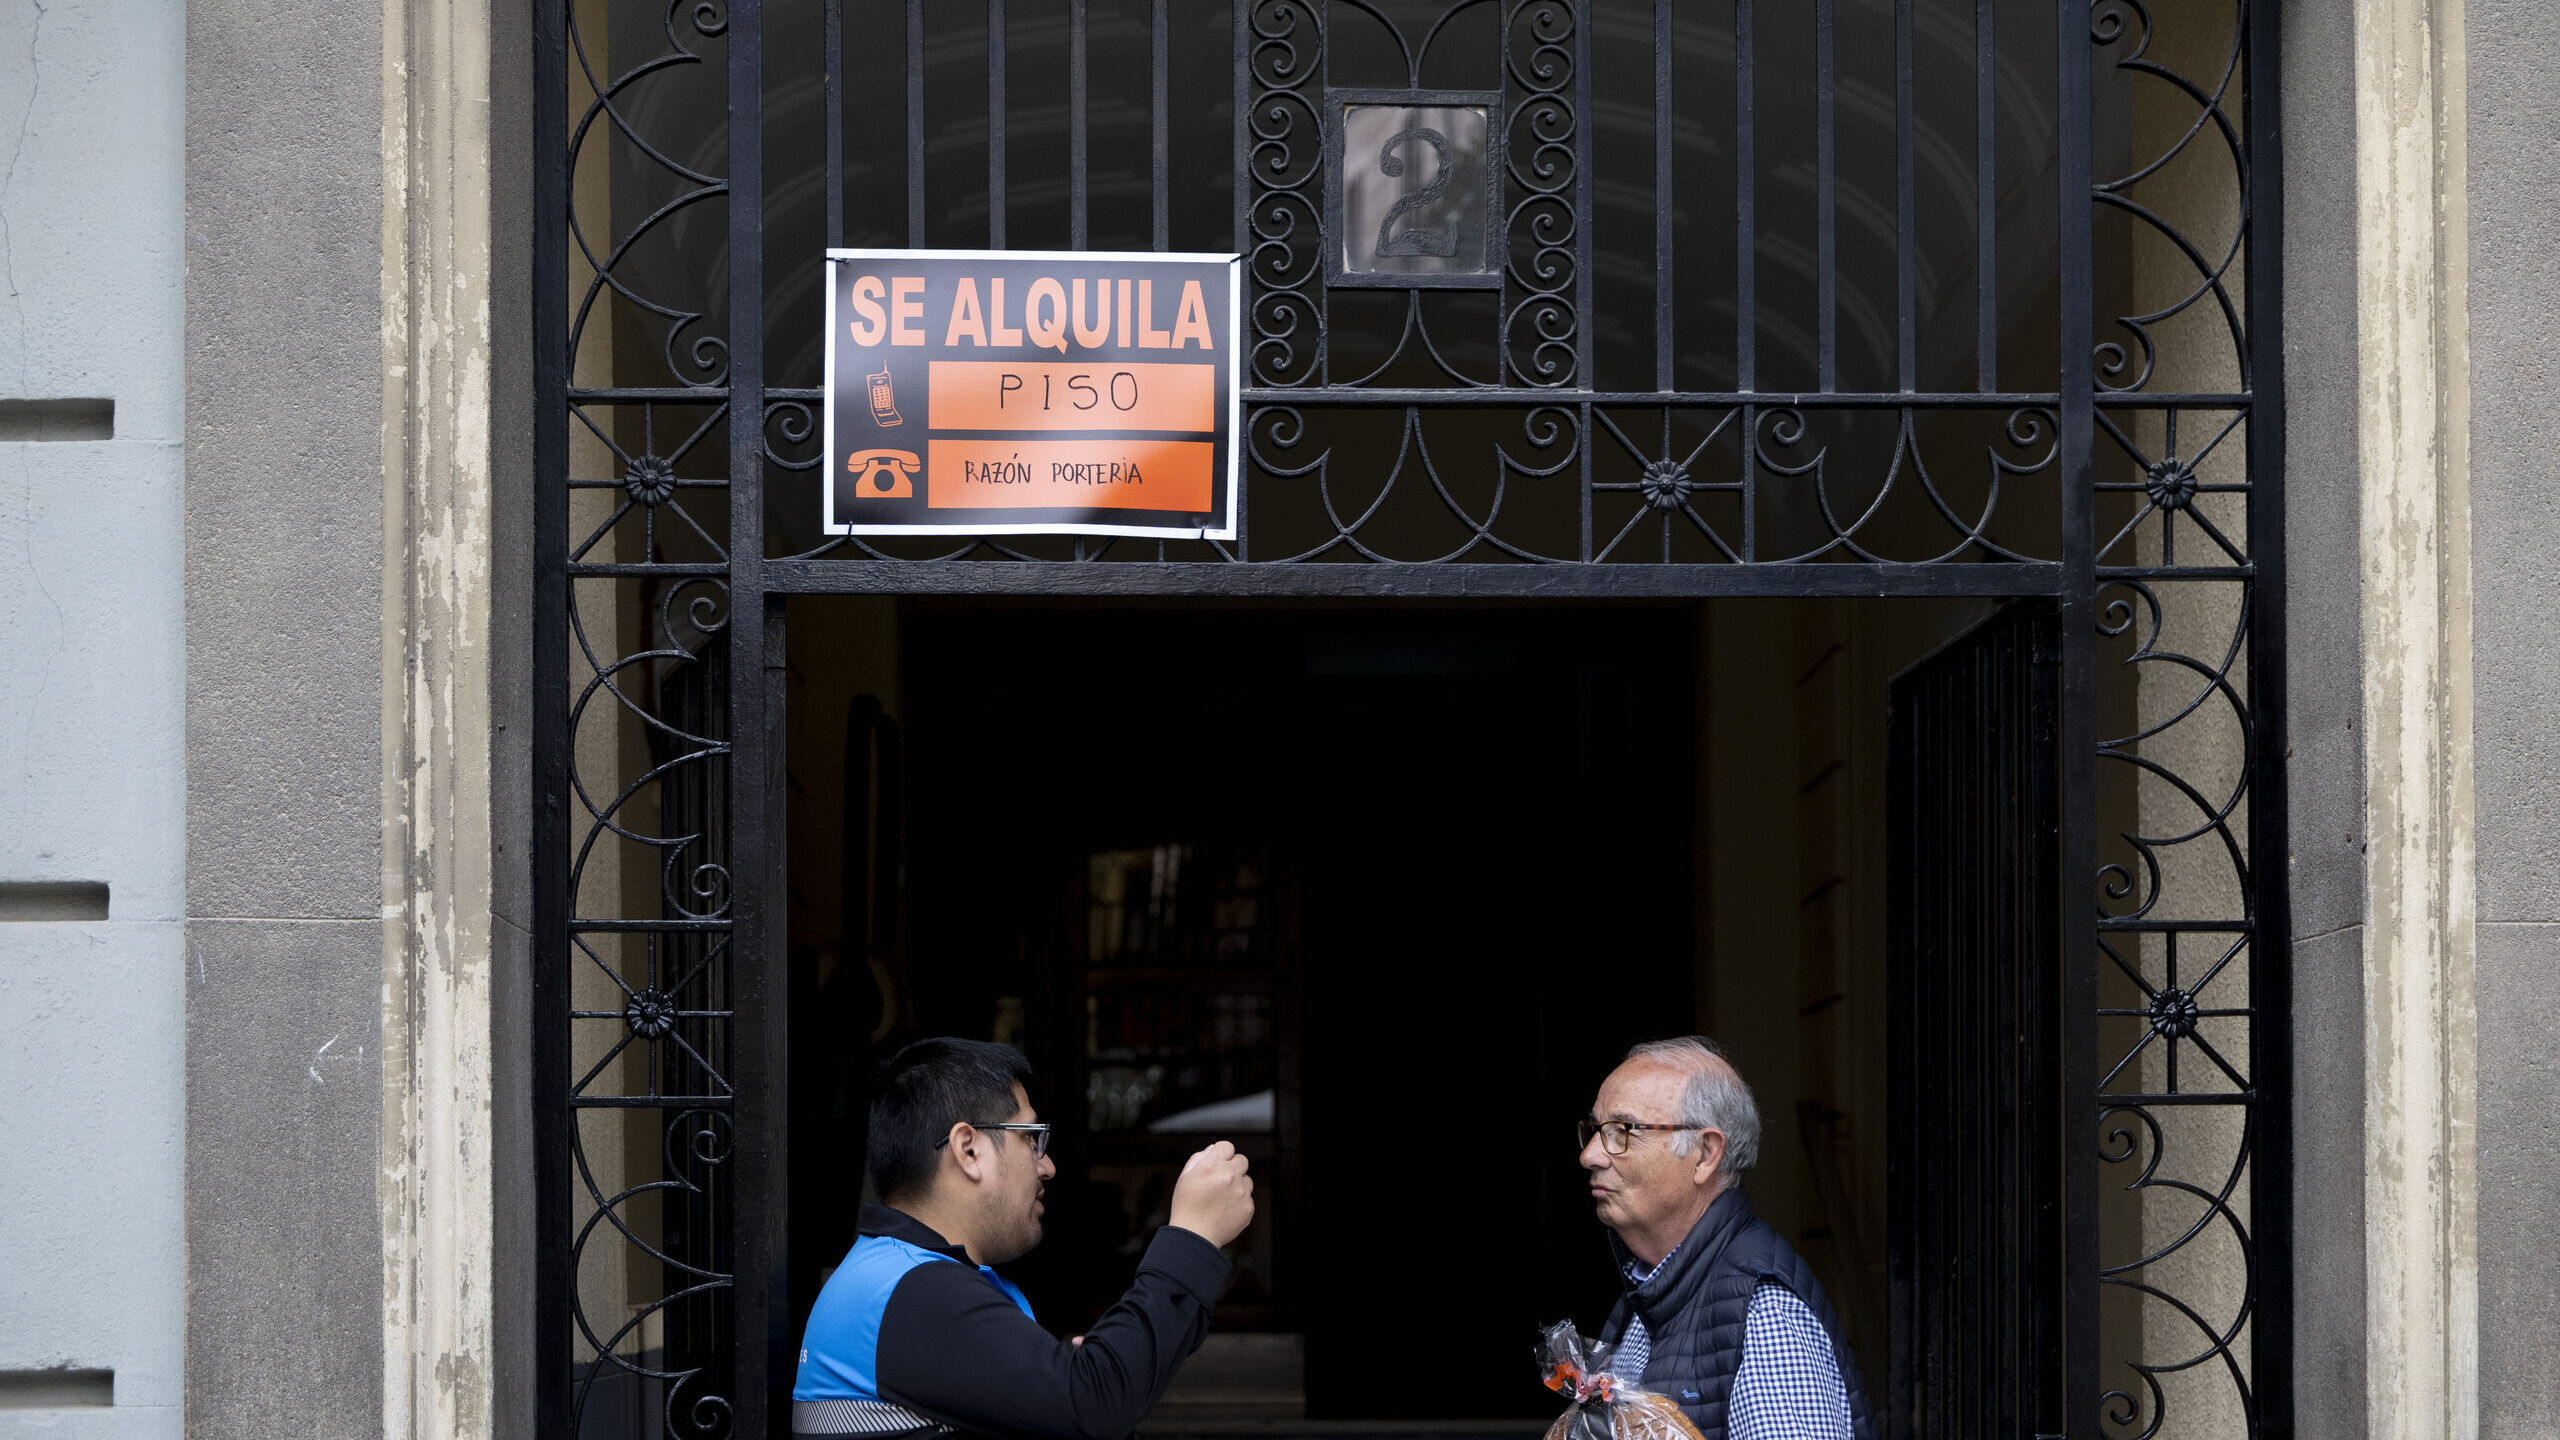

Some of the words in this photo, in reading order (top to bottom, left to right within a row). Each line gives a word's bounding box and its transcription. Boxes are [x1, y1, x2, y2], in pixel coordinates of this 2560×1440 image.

[1375, 127, 1458, 258] 2
[849, 274, 926, 348] SE
[944, 276, 1214, 355] ALQUILA
[1000, 371, 1139, 412] PISO
[965, 452, 1032, 485] RAZÓN
